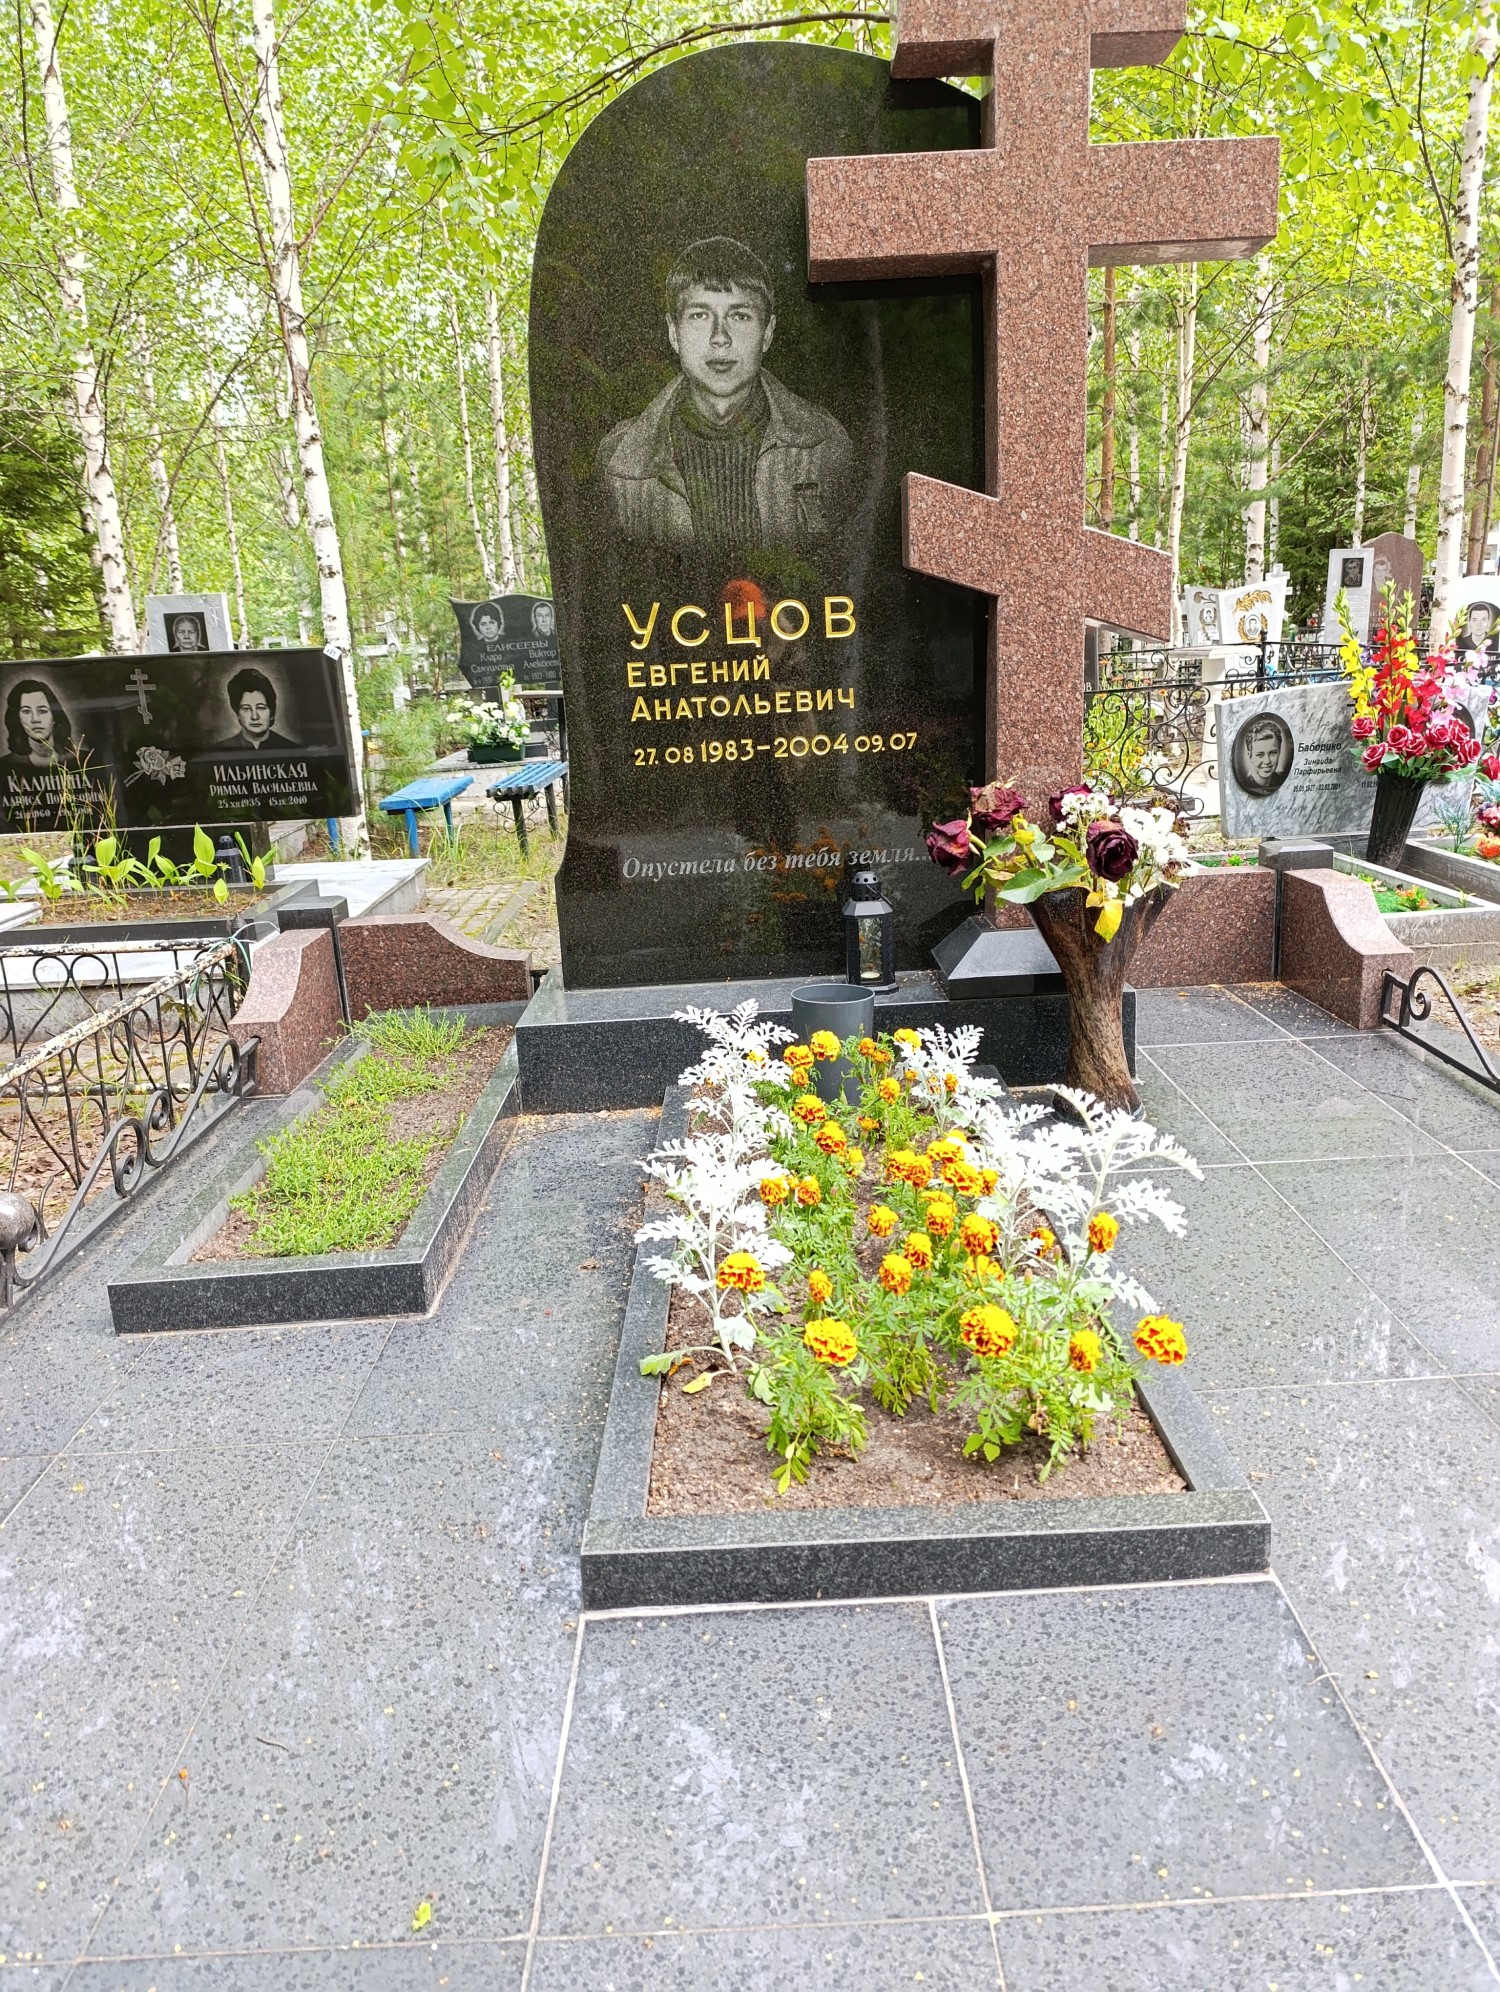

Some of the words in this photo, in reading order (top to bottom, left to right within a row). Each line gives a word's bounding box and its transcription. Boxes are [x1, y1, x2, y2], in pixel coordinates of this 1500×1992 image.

[622, 596, 857, 650] УСЦОВ
[486, 640, 549, 652] ЕЛИСЕЕВЫ
[480, 652, 503, 663] Клара
[528, 649, 557, 660] Виктор
[626, 654, 770, 688] ЕВГЕНИЙ
[631, 687, 855, 722] АНАТОЛЬЕВИЧ
[1298, 742, 1342, 753] Баборико
[1303, 757, 1333, 766] Зинаида
[213, 762, 308, 783] ИЛЬИНСКАЯ
[209, 784, 248, 797] РИММА
[252, 781, 318, 795] ВАСИЛЬЕВНА
[622, 856, 736, 882] Опустела
[743, 850, 778, 872] без
[784, 847, 842, 870] тебя
